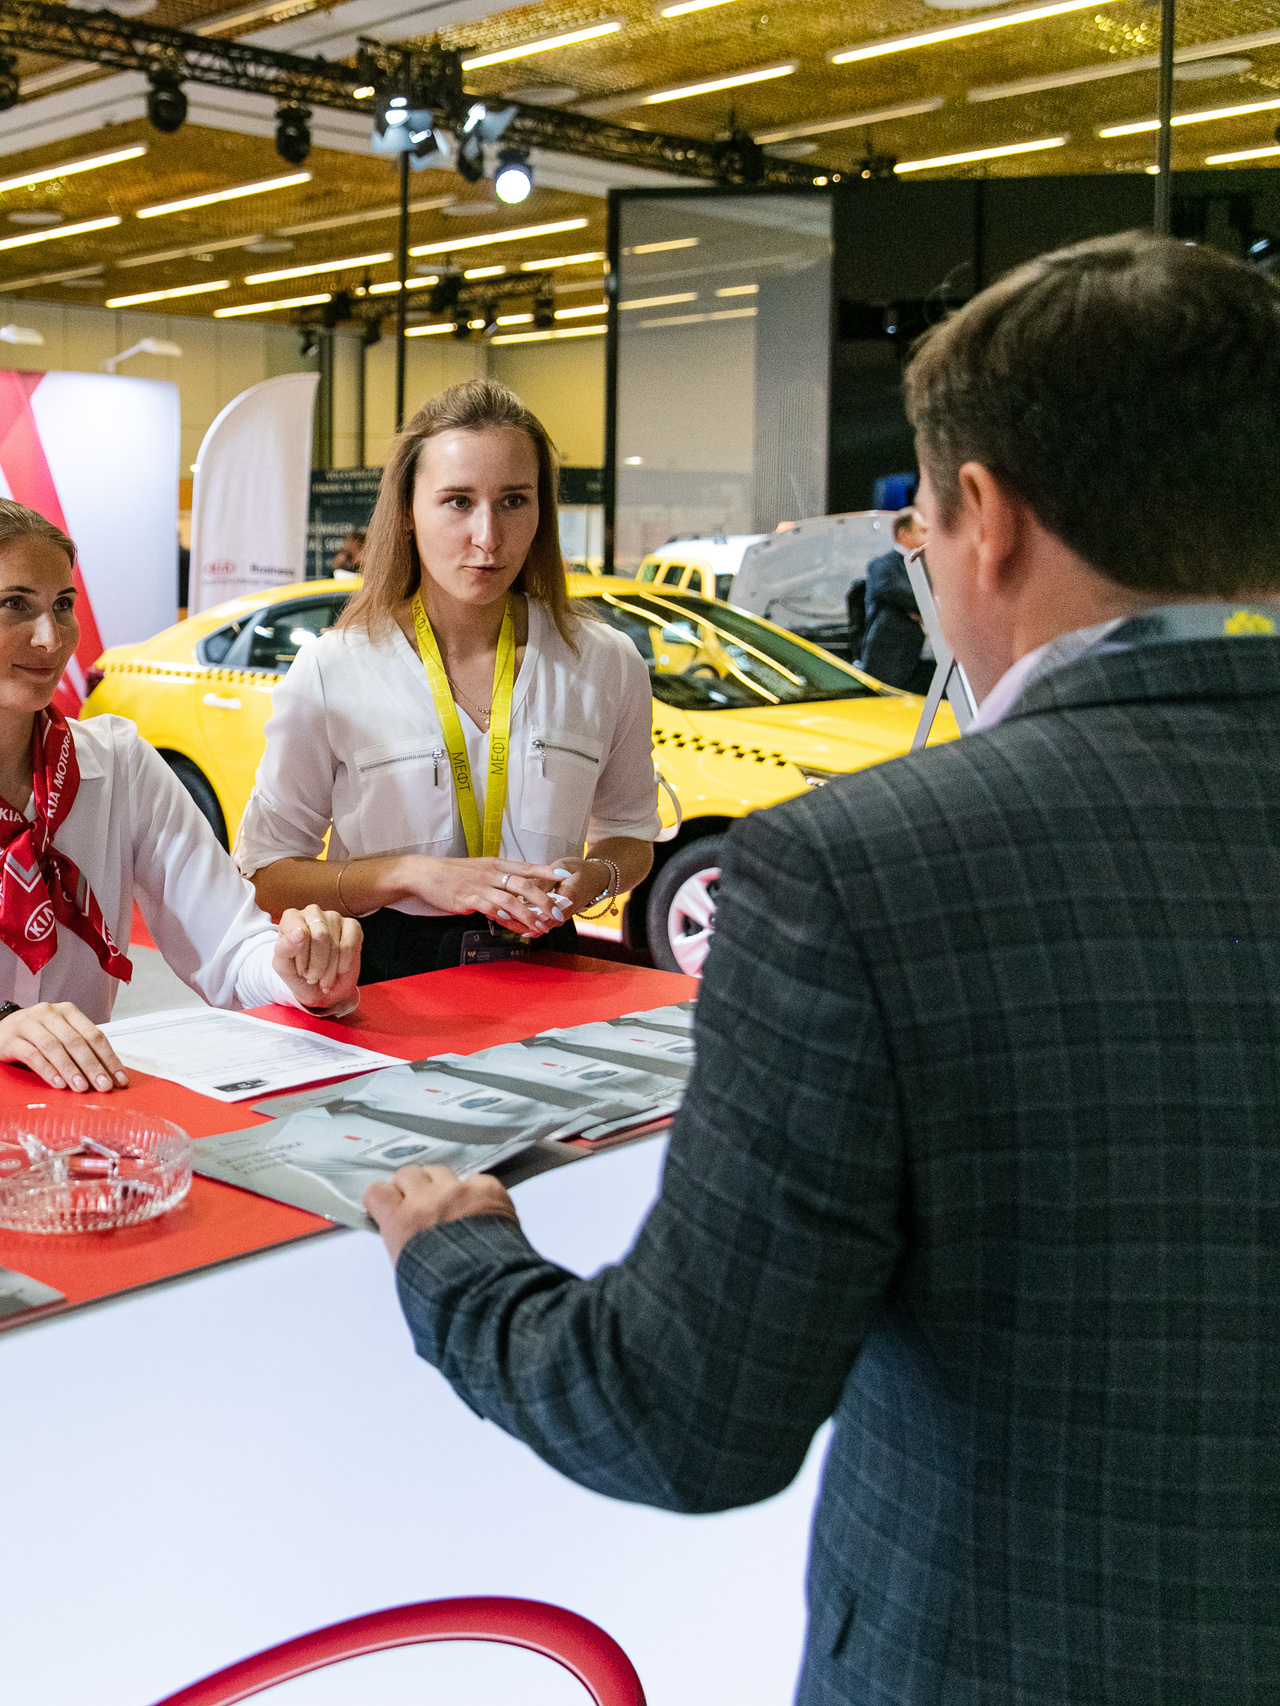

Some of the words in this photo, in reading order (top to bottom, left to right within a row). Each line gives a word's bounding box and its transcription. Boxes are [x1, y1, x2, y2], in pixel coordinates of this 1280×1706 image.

[412, 599, 430, 635] МЕФТ
[451, 751, 471, 792] МЕФТ
[491, 734, 506, 776] МЕФТ
[47, 791, 61, 819] KIA
[28, 906, 55, 938] KIA
